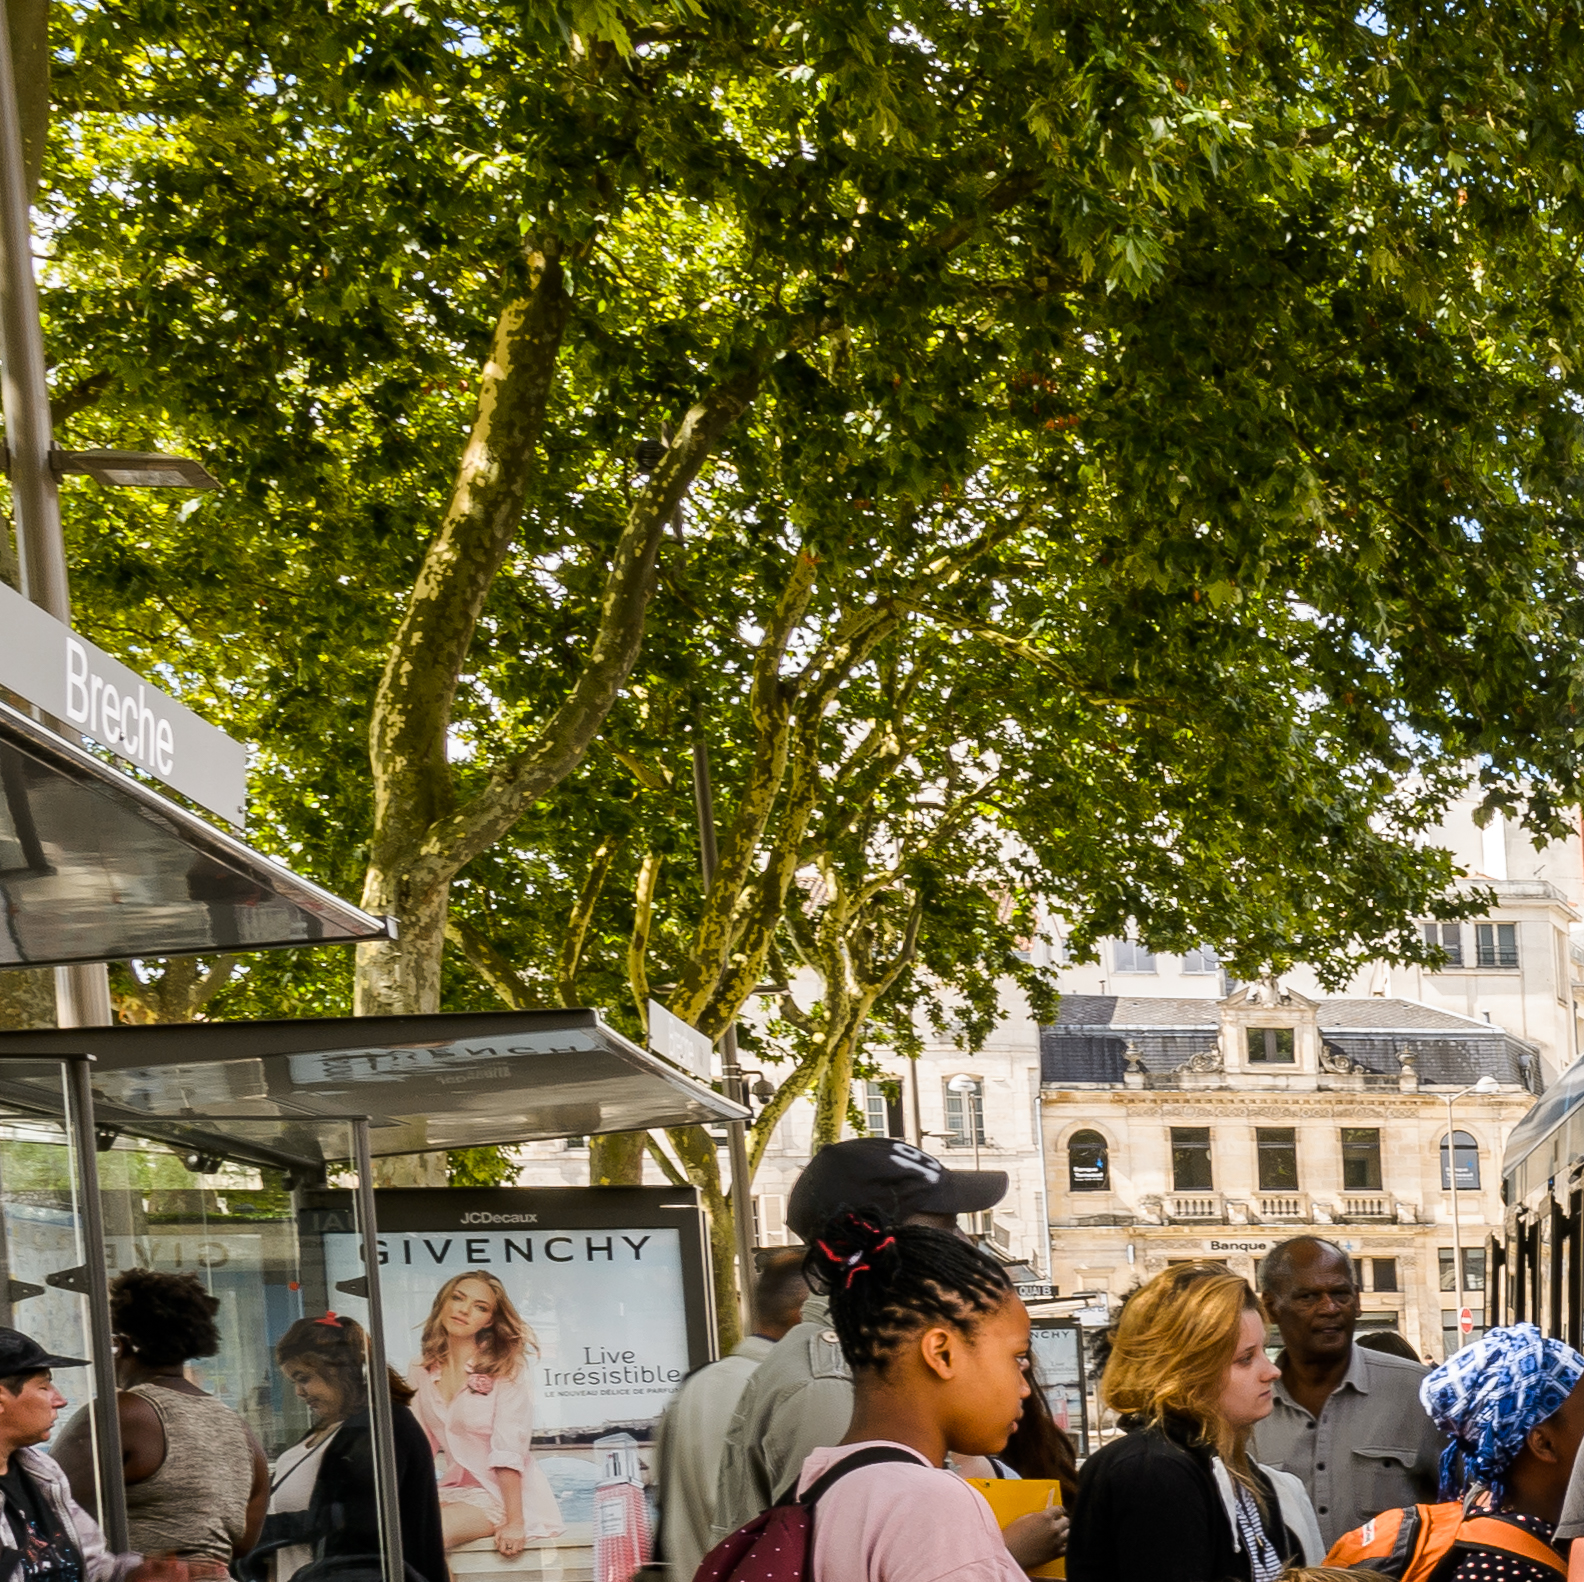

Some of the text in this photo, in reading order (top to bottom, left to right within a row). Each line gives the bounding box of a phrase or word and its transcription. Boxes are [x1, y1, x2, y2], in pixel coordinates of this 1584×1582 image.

[66, 637, 174, 776] Breche
[460, 1211, 538, 1225] JCDecaux
[359, 1235, 652, 1265] GIVENCHY
[1210, 1240, 1266, 1252] Banque
[1018, 1285, 1052, 1296] QUAI B
[583, 1346, 636, 1365] Live
[543, 1365, 682, 1387] Irrésistible
